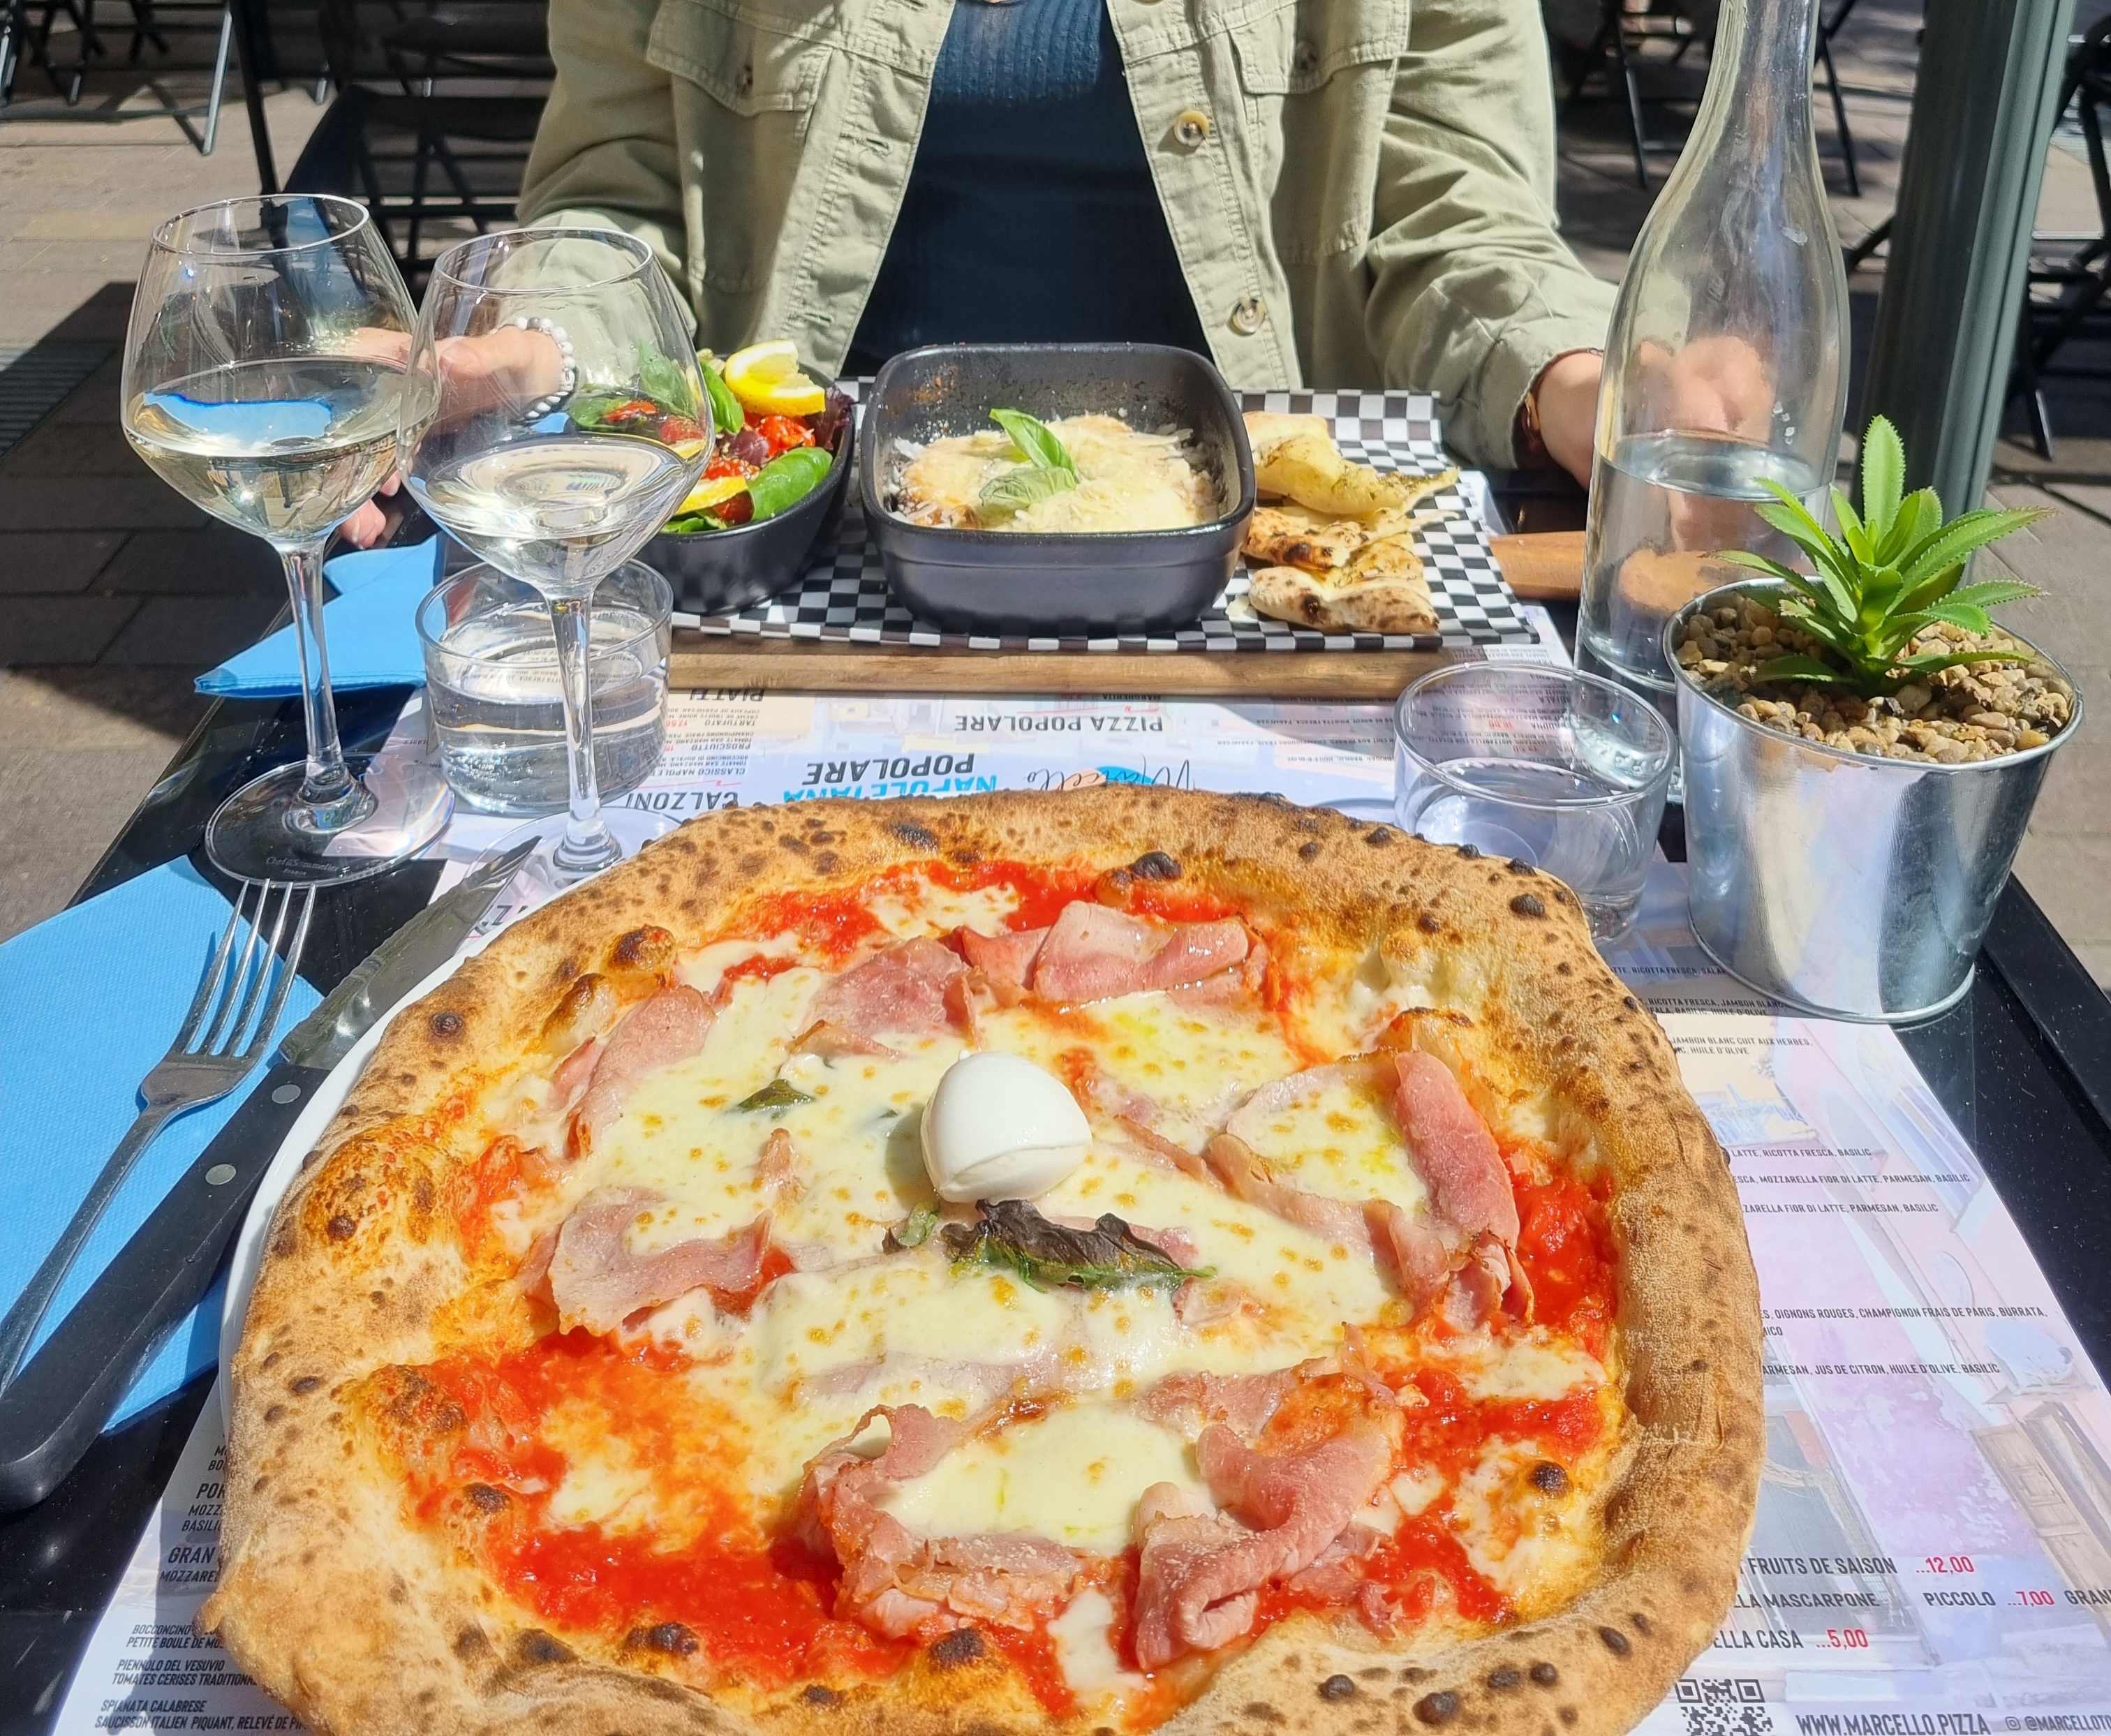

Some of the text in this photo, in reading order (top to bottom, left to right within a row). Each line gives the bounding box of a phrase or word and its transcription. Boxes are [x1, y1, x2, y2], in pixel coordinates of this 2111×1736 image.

[954, 715, 1163, 732] PIZZA POPOLARE
[801, 753, 975, 785] POPOLARE
[1631, 966, 1665, 974] RICOTTA
[1648, 997, 1683, 1006] RICOTTA
[1684, 998, 1719, 1007] FRESCA,
[1721, 999, 1755, 1007] JAMBON
[1707, 1037, 1735, 1045] BLANC
[1736, 1037, 1756, 1045] CUIT
[1757, 1037, 1775, 1046] AUX
[1716, 1046, 1750, 1055] D'OLIVE
[1800, 1149, 1837, 1157] FRESCA,
[1837, 1148, 1872, 1157] BASILIC
[1759, 1175, 1819, 1184] MOZZARELLA
[1819, 1175, 1840, 1184] FIOR
[1840, 1175, 1850, 1183] DI
[1851, 1175, 1883, 1184] LATTE,
[1883, 1174, 1935, 1183] PARMESAN,
[1936, 1173, 1971, 1183] BASILIC
[1742, 1204, 1784, 1213] ZARELLA
[1784, 1204, 1806, 1213] FIOR
[1818, 1204, 1849, 1214] LATTE,
[1849, 1203, 1902, 1213] PARMESAN,
[1903, 1203, 1939, 1212] BASILIC
[1774, 1309, 1816, 1319] OIGNONS
[1816, 1308, 1858, 1319] ROUGES,
[1858, 1307, 1920, 1318] CHAMPIGNON
[1922, 1307, 1950, 1317] FRAIS
[1951, 1307, 1964, 1317] DE
[1965, 1307, 1999, 1318] PARIS,
[1999, 1307, 2047, 1317] BURRATA,
[1814, 1365, 1833, 1374] JUS
[1834, 1365, 1849, 1374] DE
[1849, 1365, 1889, 1376] CITRON,
[1889, 1364, 1920, 1374] HUILE
[1920, 1364, 1961, 1375] D'OLIVE,
[1961, 1363, 2001, 1374] BASILIC
[168, 1546, 216, 1564] GRAN
[1747, 1557, 1808, 1575] FRUITS
[1808, 1557, 1835, 1574] DE
[1835, 1557, 1899, 1574] SAISON
[1763, 1593, 1881, 1608] MASCARPONE
[1923, 1592, 1997, 1606] PICCOLO
[132, 1624, 192, 1635] BOCCONCINO
[126, 1637, 158, 1648] PETITE
[158, 1638, 191, 1648] BOULE
[191, 1638, 205, 1648] DE
[1756, 1629, 1805, 1648] CASA
[117, 1659, 225, 1672] PIENNOLO DEL VESUVIO
[112, 1672, 156, 1685] TOMATES
[156, 1673, 196, 1686] CERISES
[101, 1699, 207, 1713] SPIANATA CALABRESE
[94, 1716, 149, 1729] SAUCISSON
[150, 1716, 188, 1729] ITALIEN
[190, 1716, 235, 1731] PIQUANT,
[237, 1714, 275, 1730] RELEVÉ
[275, 1716, 290, 1730] DE
[1795, 1713, 1992, 1736] WWW.MARCELLO.PIZZA
